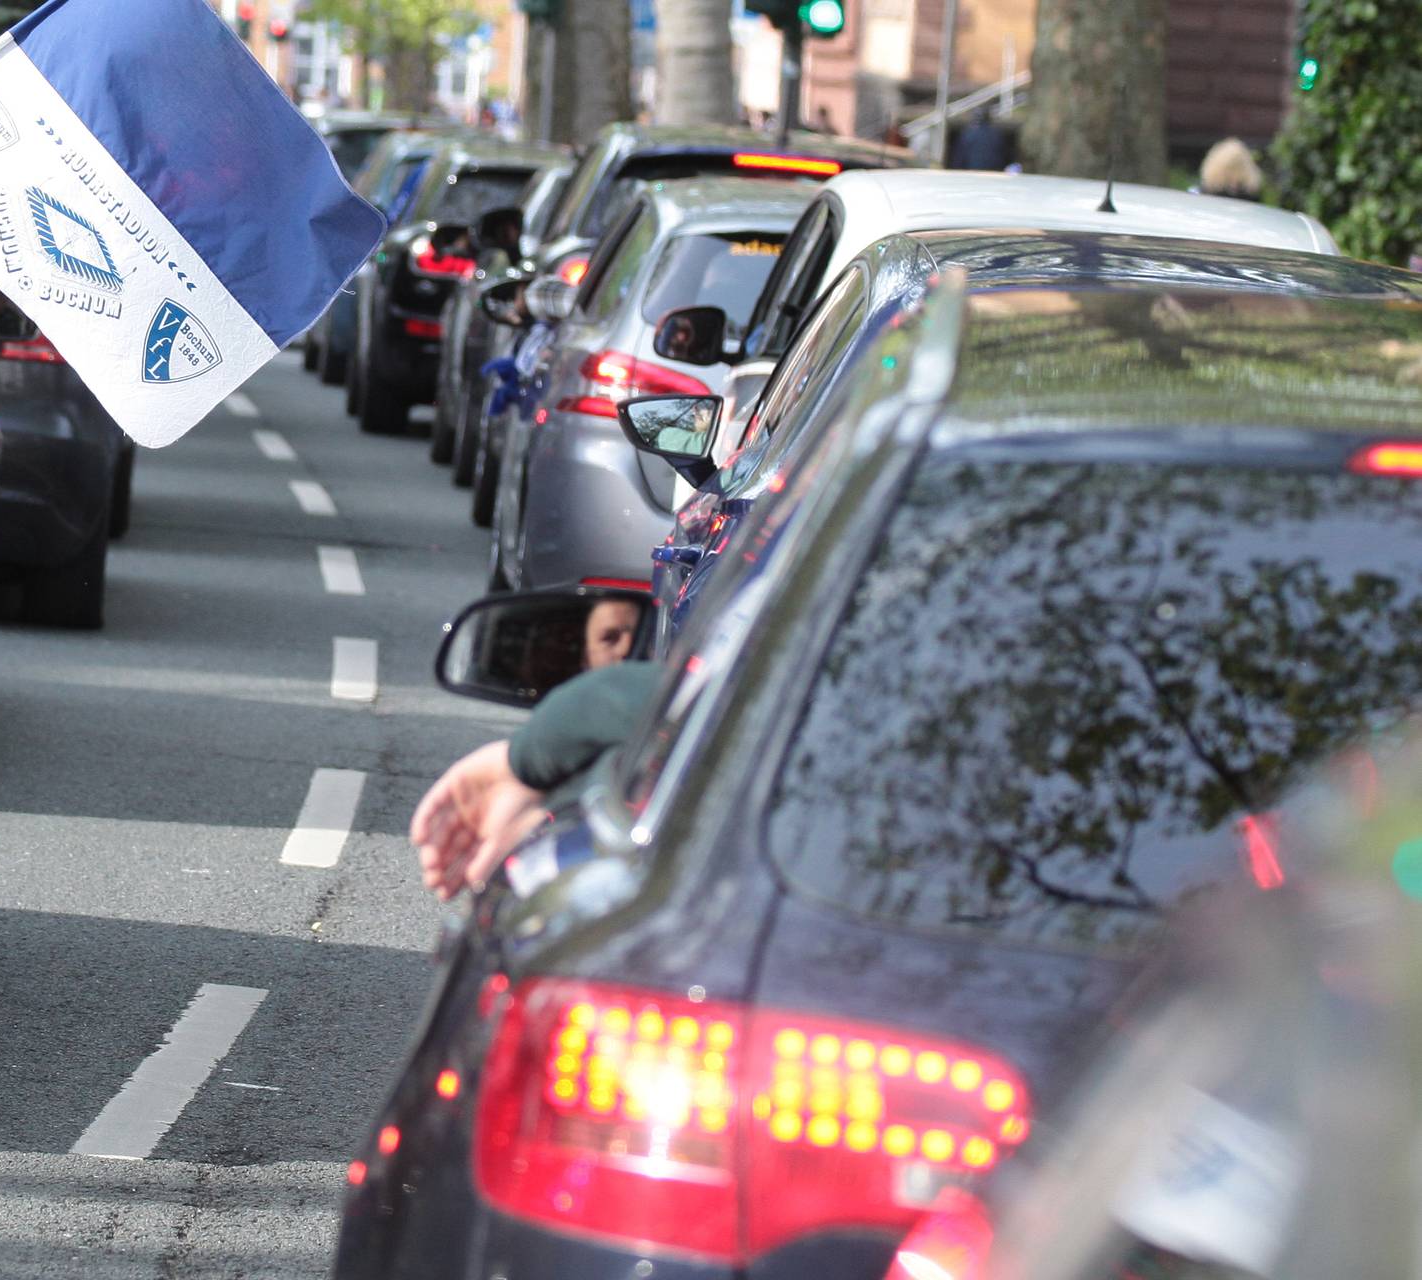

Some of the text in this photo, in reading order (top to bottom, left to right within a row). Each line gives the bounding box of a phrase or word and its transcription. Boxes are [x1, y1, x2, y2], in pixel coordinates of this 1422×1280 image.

[60, 147, 170, 265] RUHRSTADION
[37, 281, 123, 320] BOCHUM
[146, 306, 181, 380] VfL
[178, 342, 200, 367] 1848
[179, 322, 215, 364] Bochum
